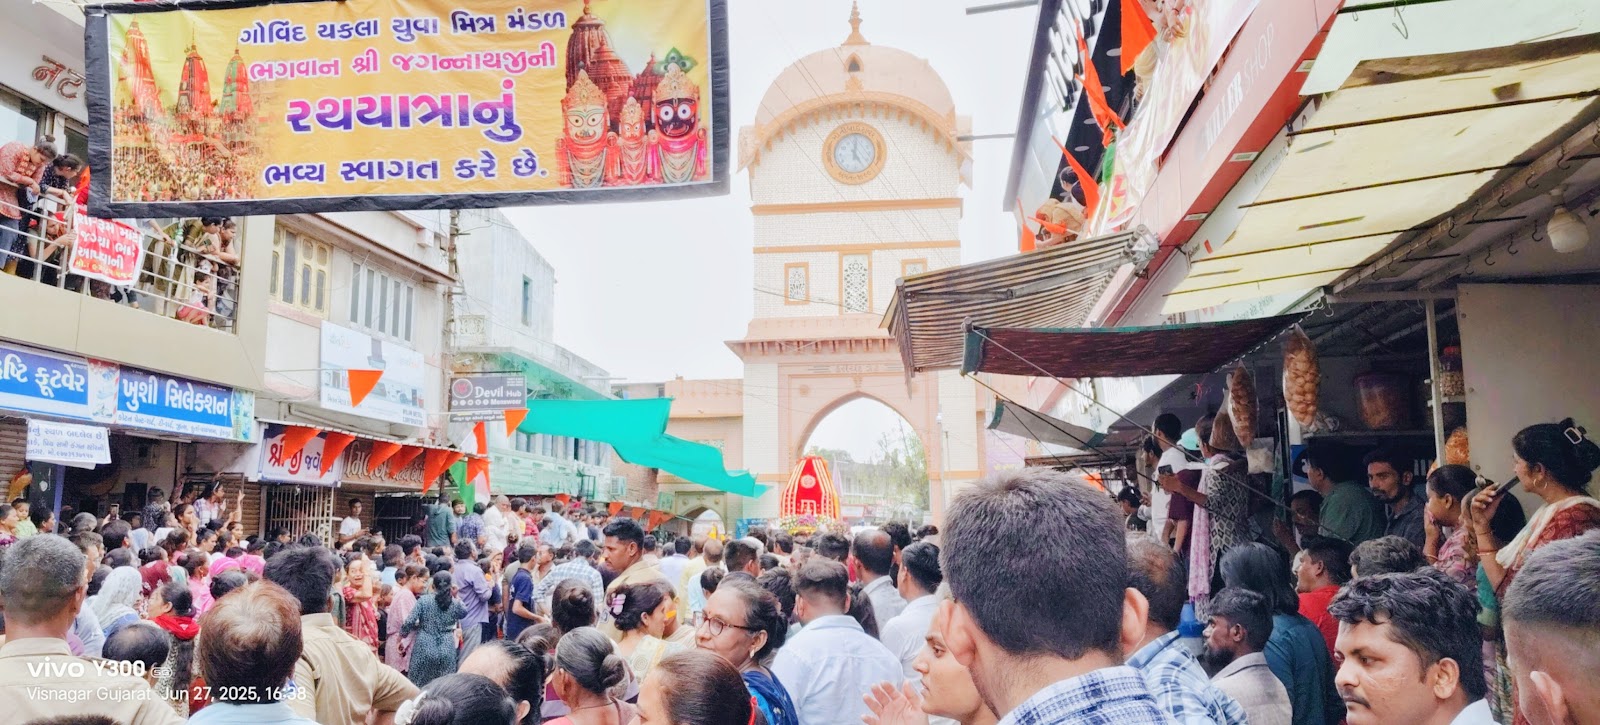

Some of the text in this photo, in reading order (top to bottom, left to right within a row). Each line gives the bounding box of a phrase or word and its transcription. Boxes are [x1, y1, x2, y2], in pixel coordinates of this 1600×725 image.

[239, 11, 567, 45] ગોવિંદ ચકલા યુવા મિત્ર મંડળ
[32, 55, 86, 99] नट
[249, 41, 556, 80] ભગવાન શ્રી જગન્નાથજીની
[1244, 22, 1274, 96] SHOP
[286, 78, 523, 144] રથયાત્રાનું
[262, 148, 547, 187] ભવ્ય સ્વાગત કરે છે.
[35, 363, 85, 398] ફૂટવેર
[122, 375, 228, 416] ખુશી સિલેકશન
[474, 385, 504, 398] Devil
